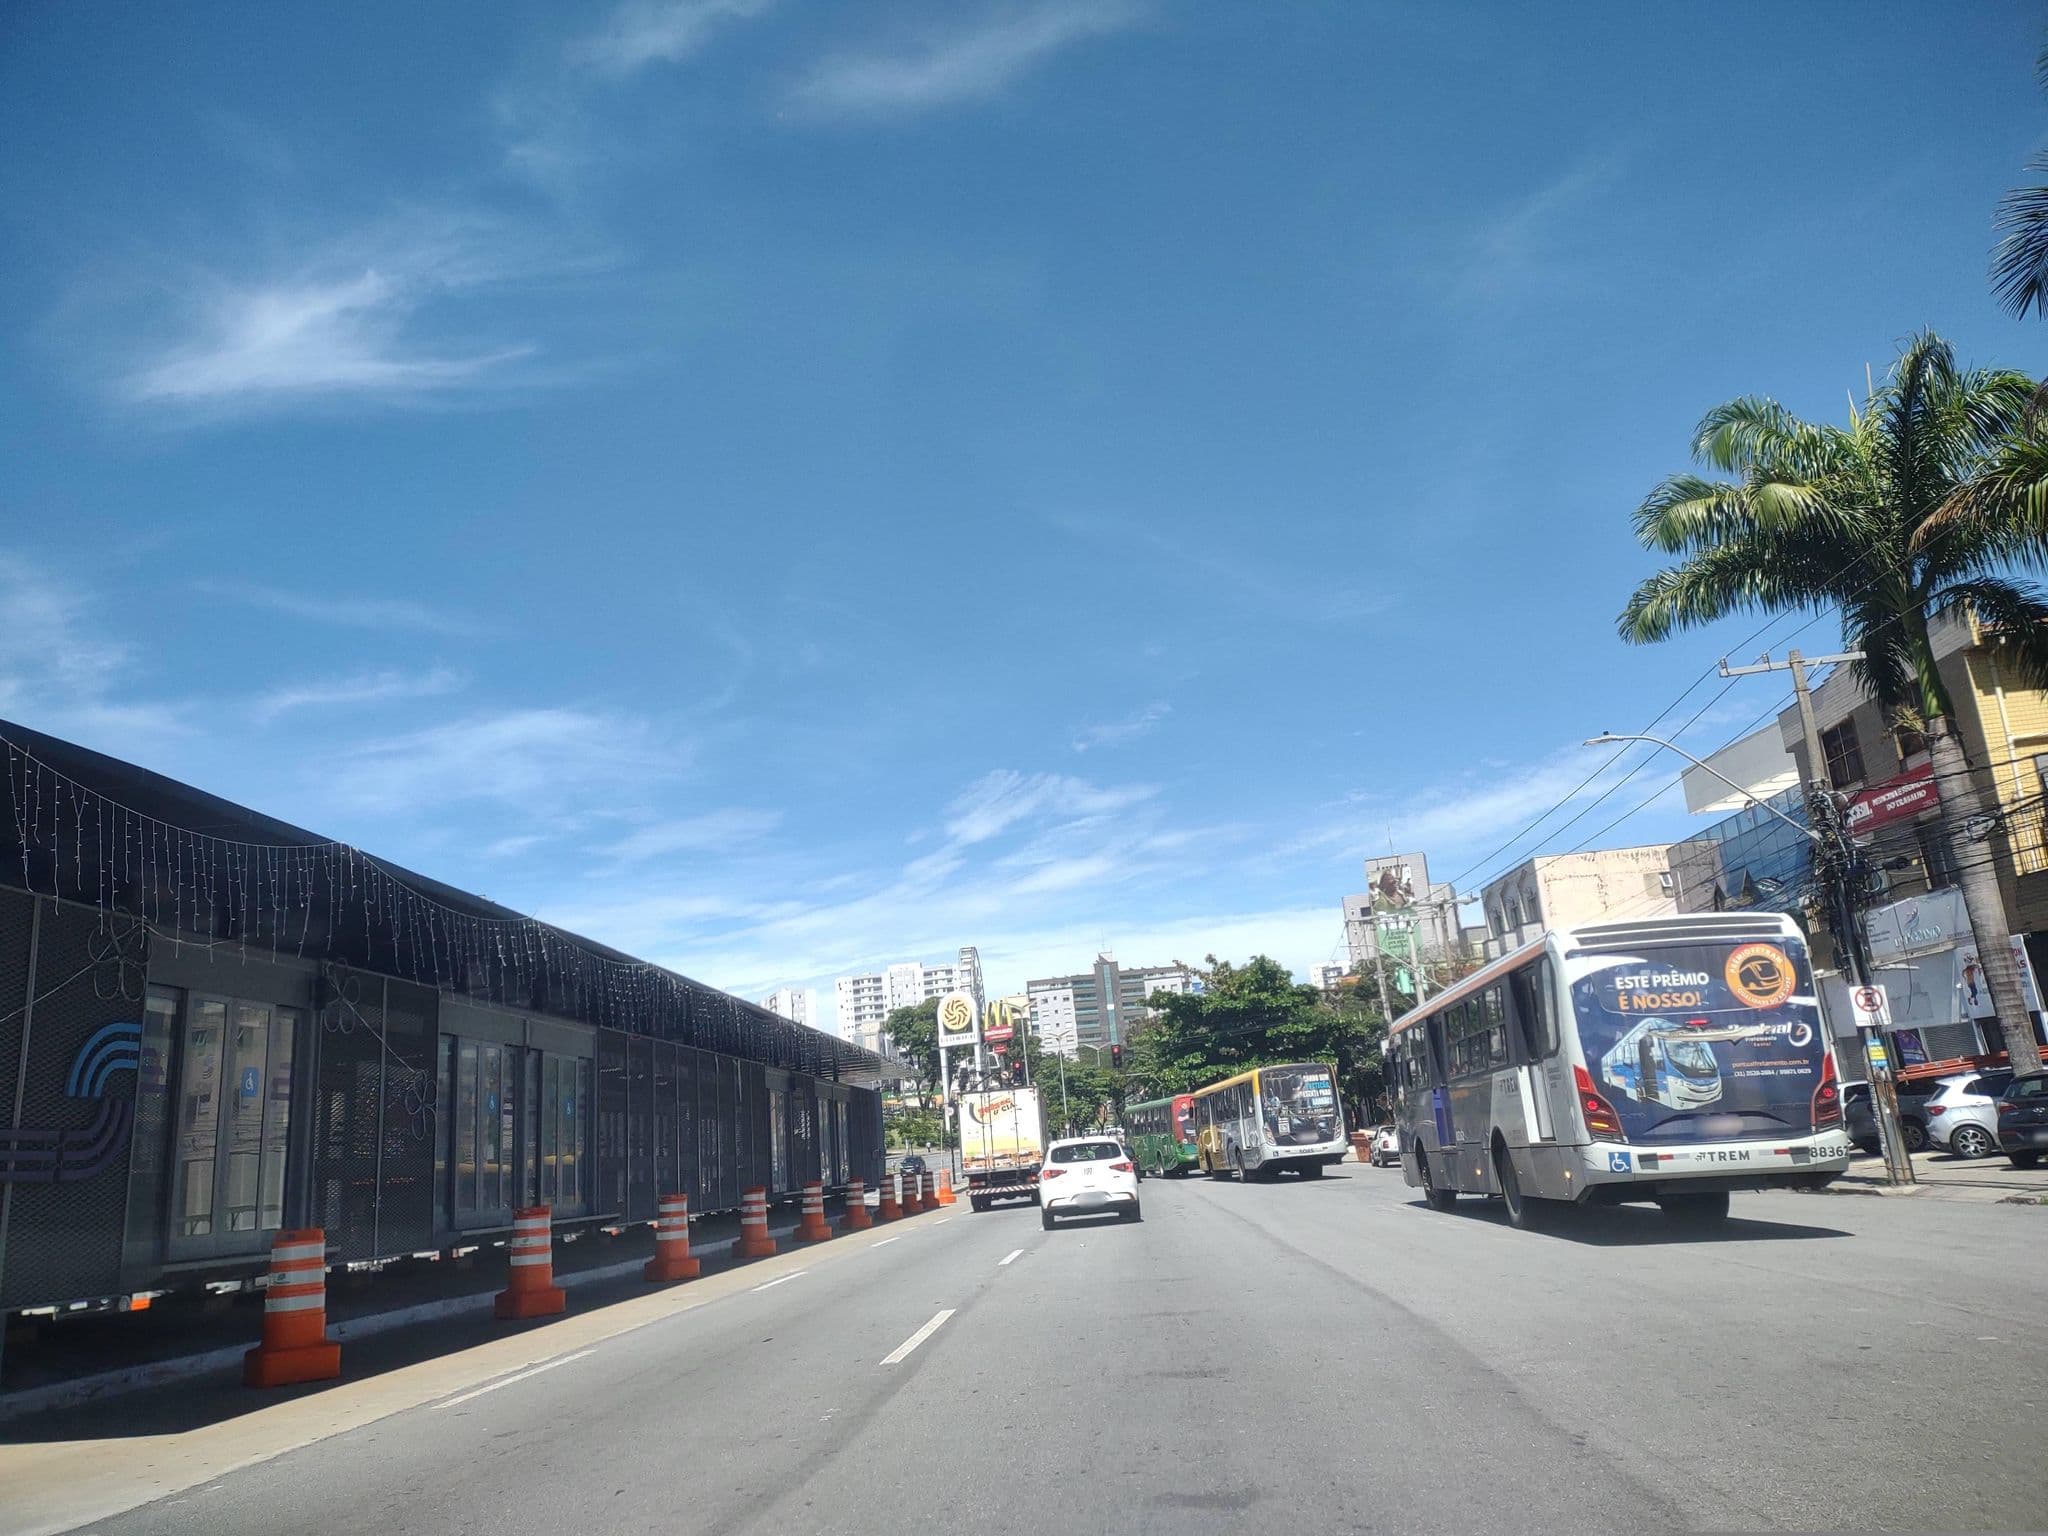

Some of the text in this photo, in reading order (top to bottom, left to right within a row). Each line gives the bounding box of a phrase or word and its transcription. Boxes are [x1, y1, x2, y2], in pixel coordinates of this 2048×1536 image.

[1615, 970, 1709, 990] ESTE PRÊMIO
[1618, 991, 1702, 1011] É NOSSO!
[1709, 1149, 1750, 1162] TREM
